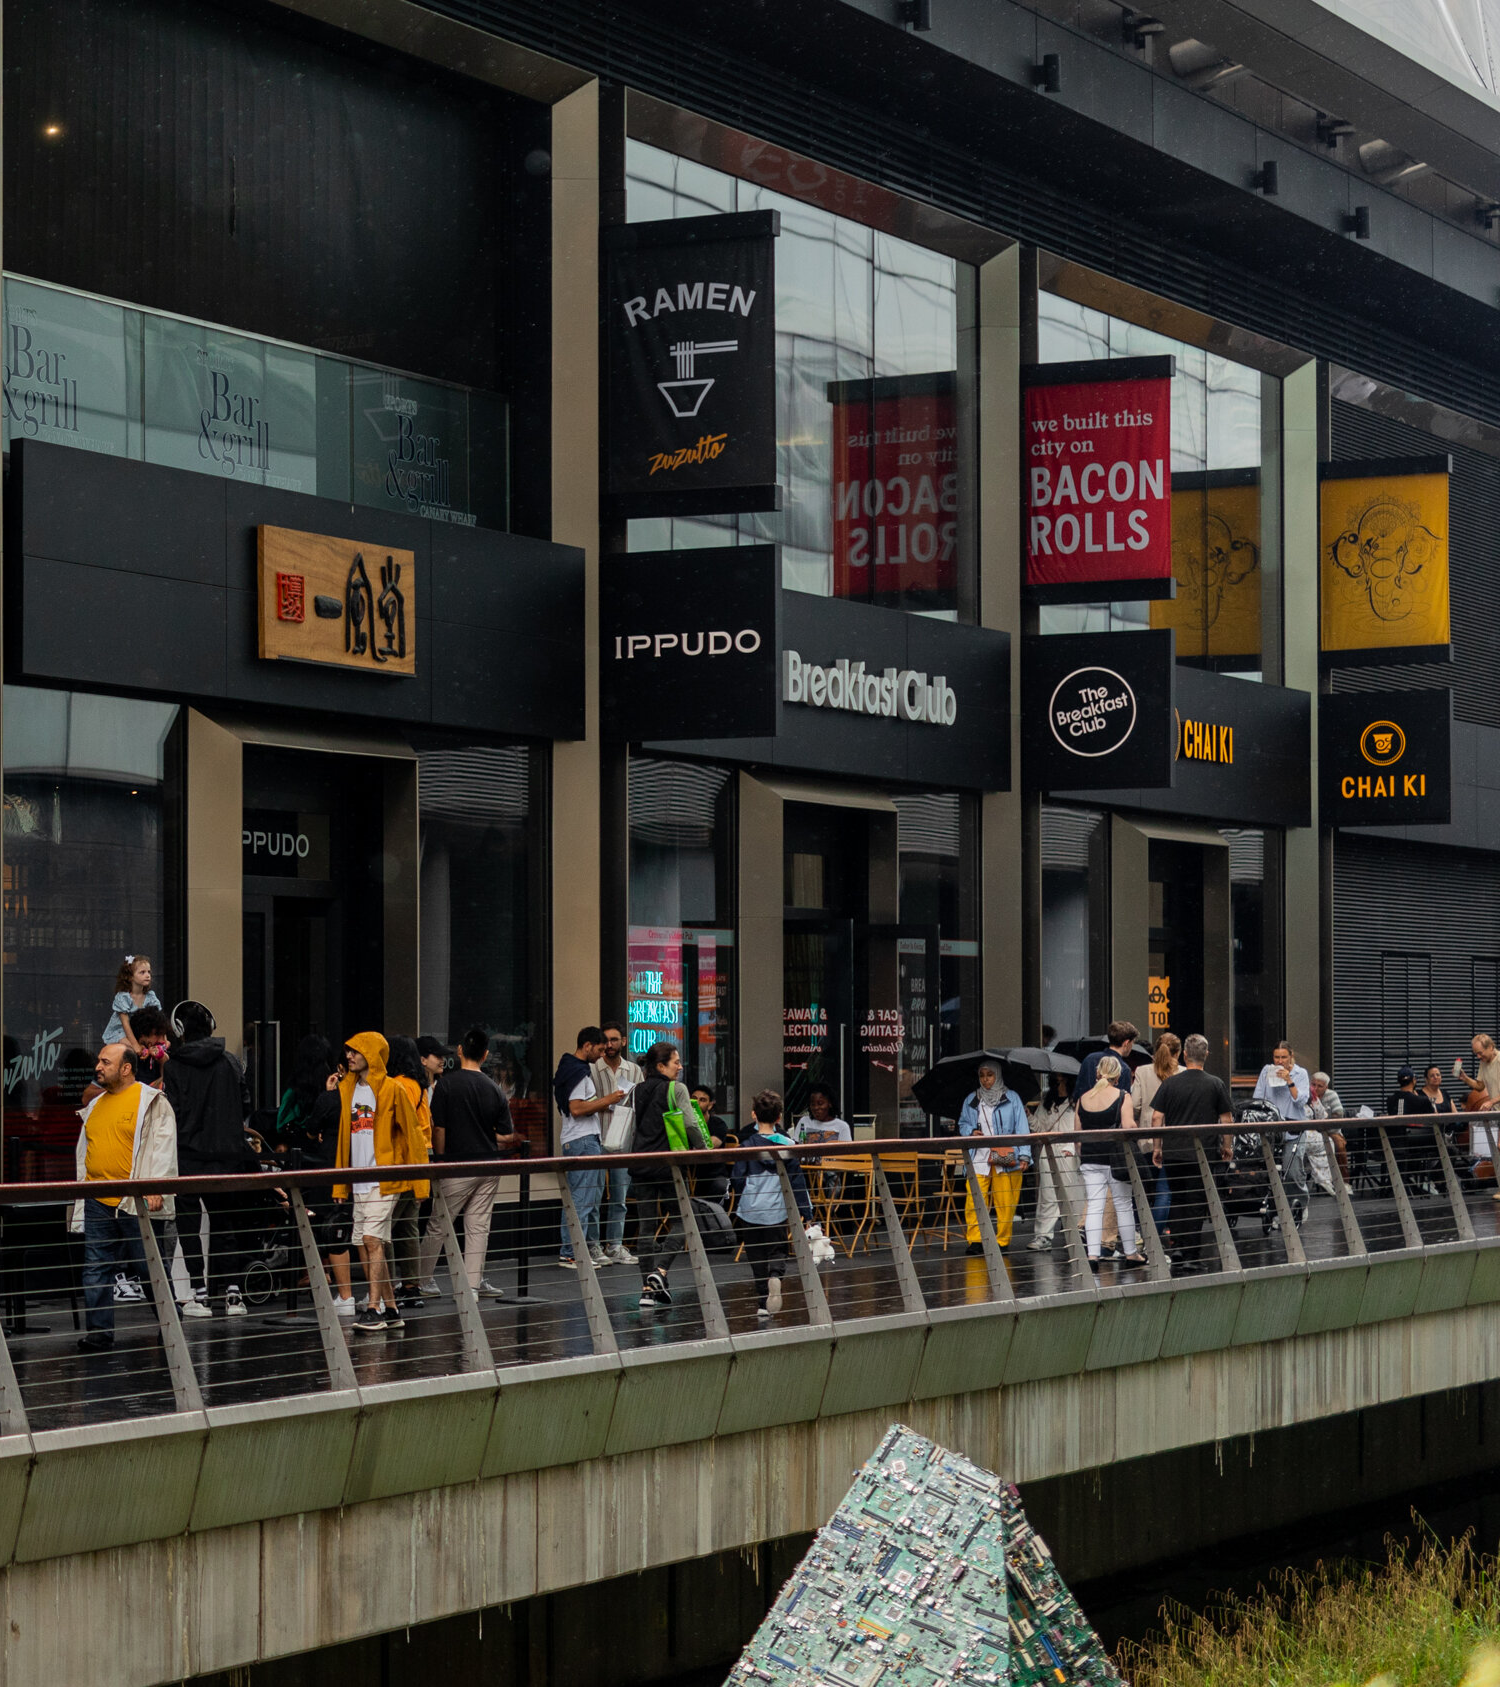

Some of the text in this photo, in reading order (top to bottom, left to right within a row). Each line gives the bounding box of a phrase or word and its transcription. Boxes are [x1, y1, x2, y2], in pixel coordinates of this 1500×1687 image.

[623, 282, 756, 328] RAMEN
[10, 324, 67, 386] Bar
[209, 371, 260, 428] Bar
[1032, 409, 1153, 432] we built this
[395, 413, 441, 467] Bar
[648, 433, 728, 475] zuzutto
[1031, 438, 1095, 459] city on
[1030, 459, 1164, 508] BACON
[1030, 509, 1151, 556] ROLLS
[615, 629, 761, 659] IPPUDO
[783, 650, 957, 726] Breakfast Club
[1056, 692, 1128, 726] Breakfast
[1078, 686, 1108, 704] The
[1069, 716, 1106, 737] Club
[1184, 719, 1233, 764] CHAI KI
[1341, 774, 1426, 799] CHAI KI
[819, 1008, 828, 1021] &
